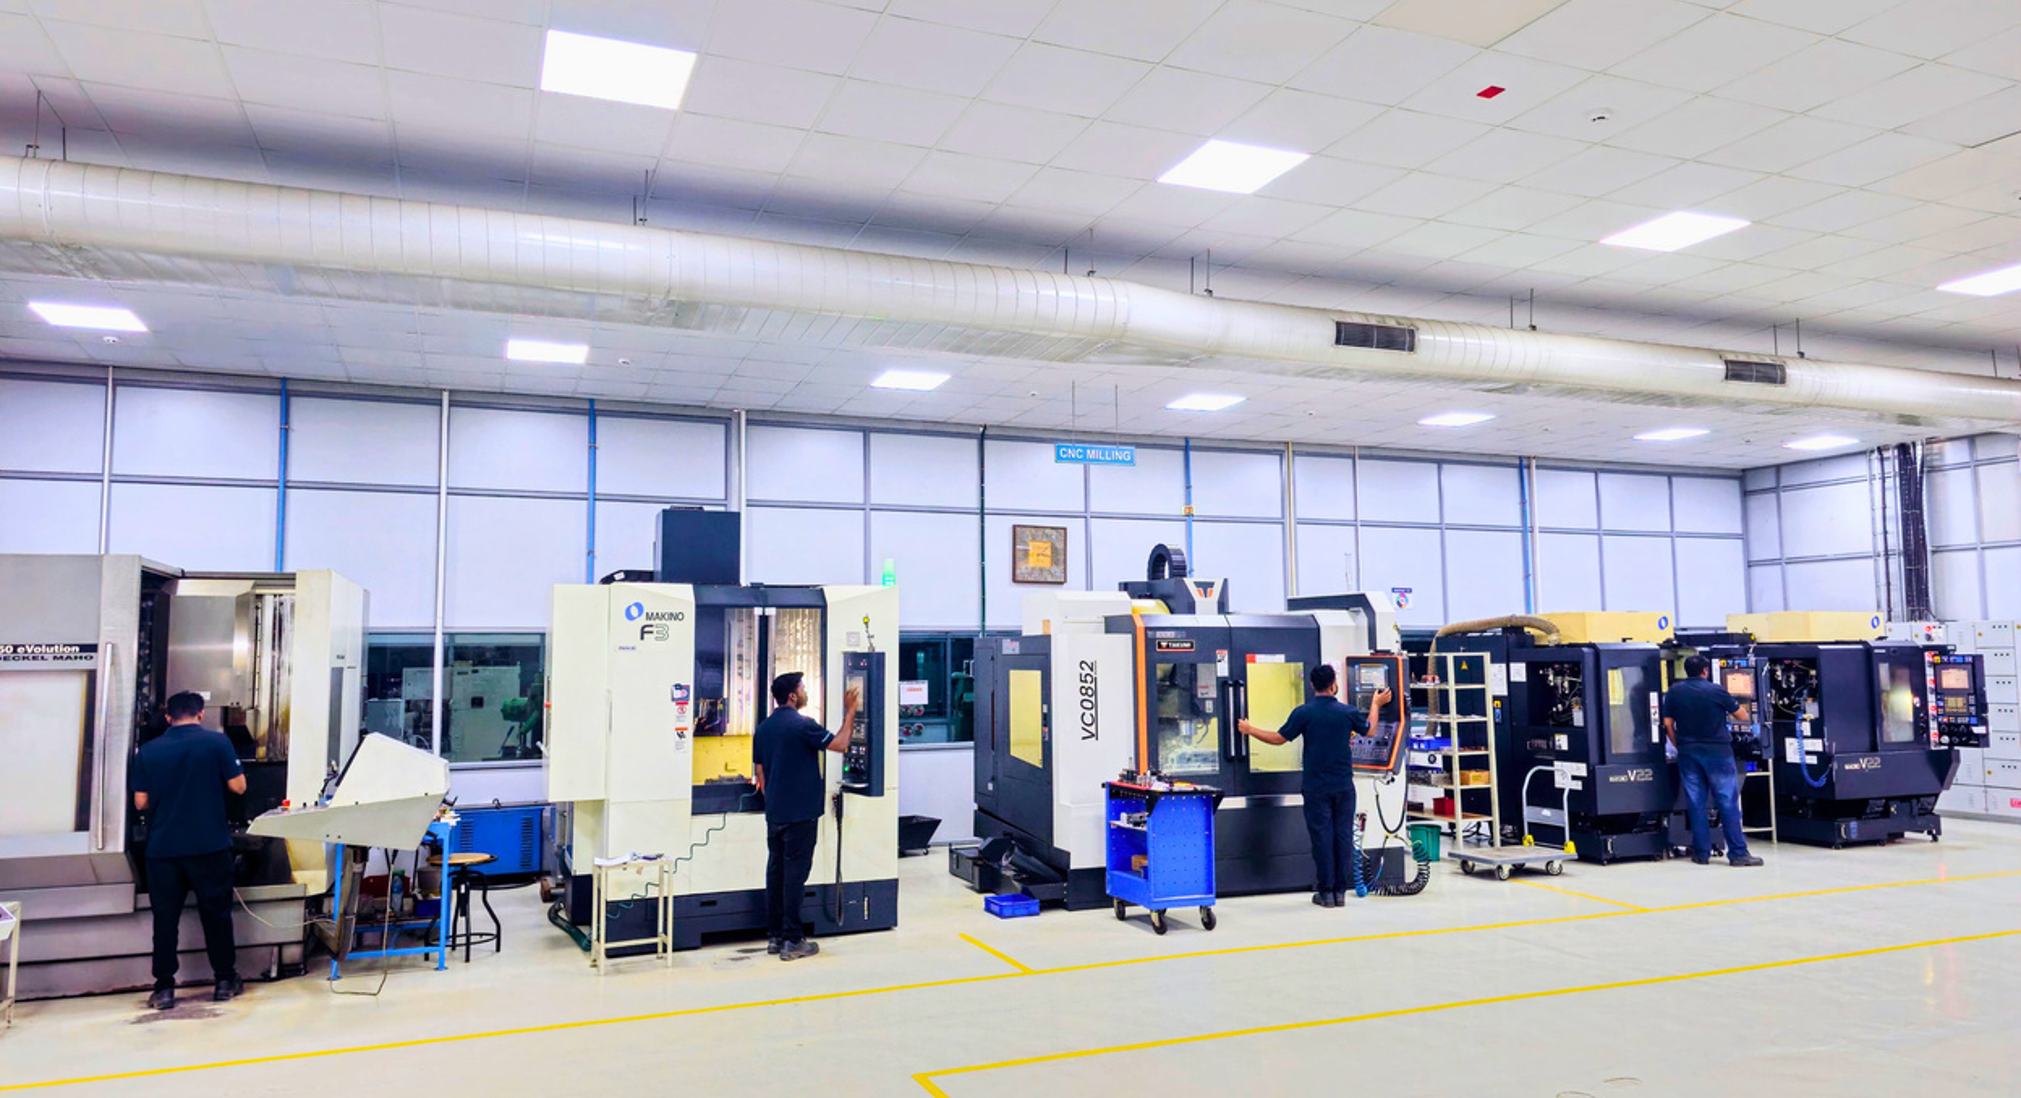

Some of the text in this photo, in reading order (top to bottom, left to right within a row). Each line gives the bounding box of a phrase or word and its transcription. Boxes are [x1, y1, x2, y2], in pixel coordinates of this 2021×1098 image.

[1060, 447, 1131, 461] CNC MILLING
[645, 611, 685, 622] MAKINO
[640, 623, 669, 641] F3
[17, 644, 80, 654] eVolution
[1627, 768, 1653, 781] V22
